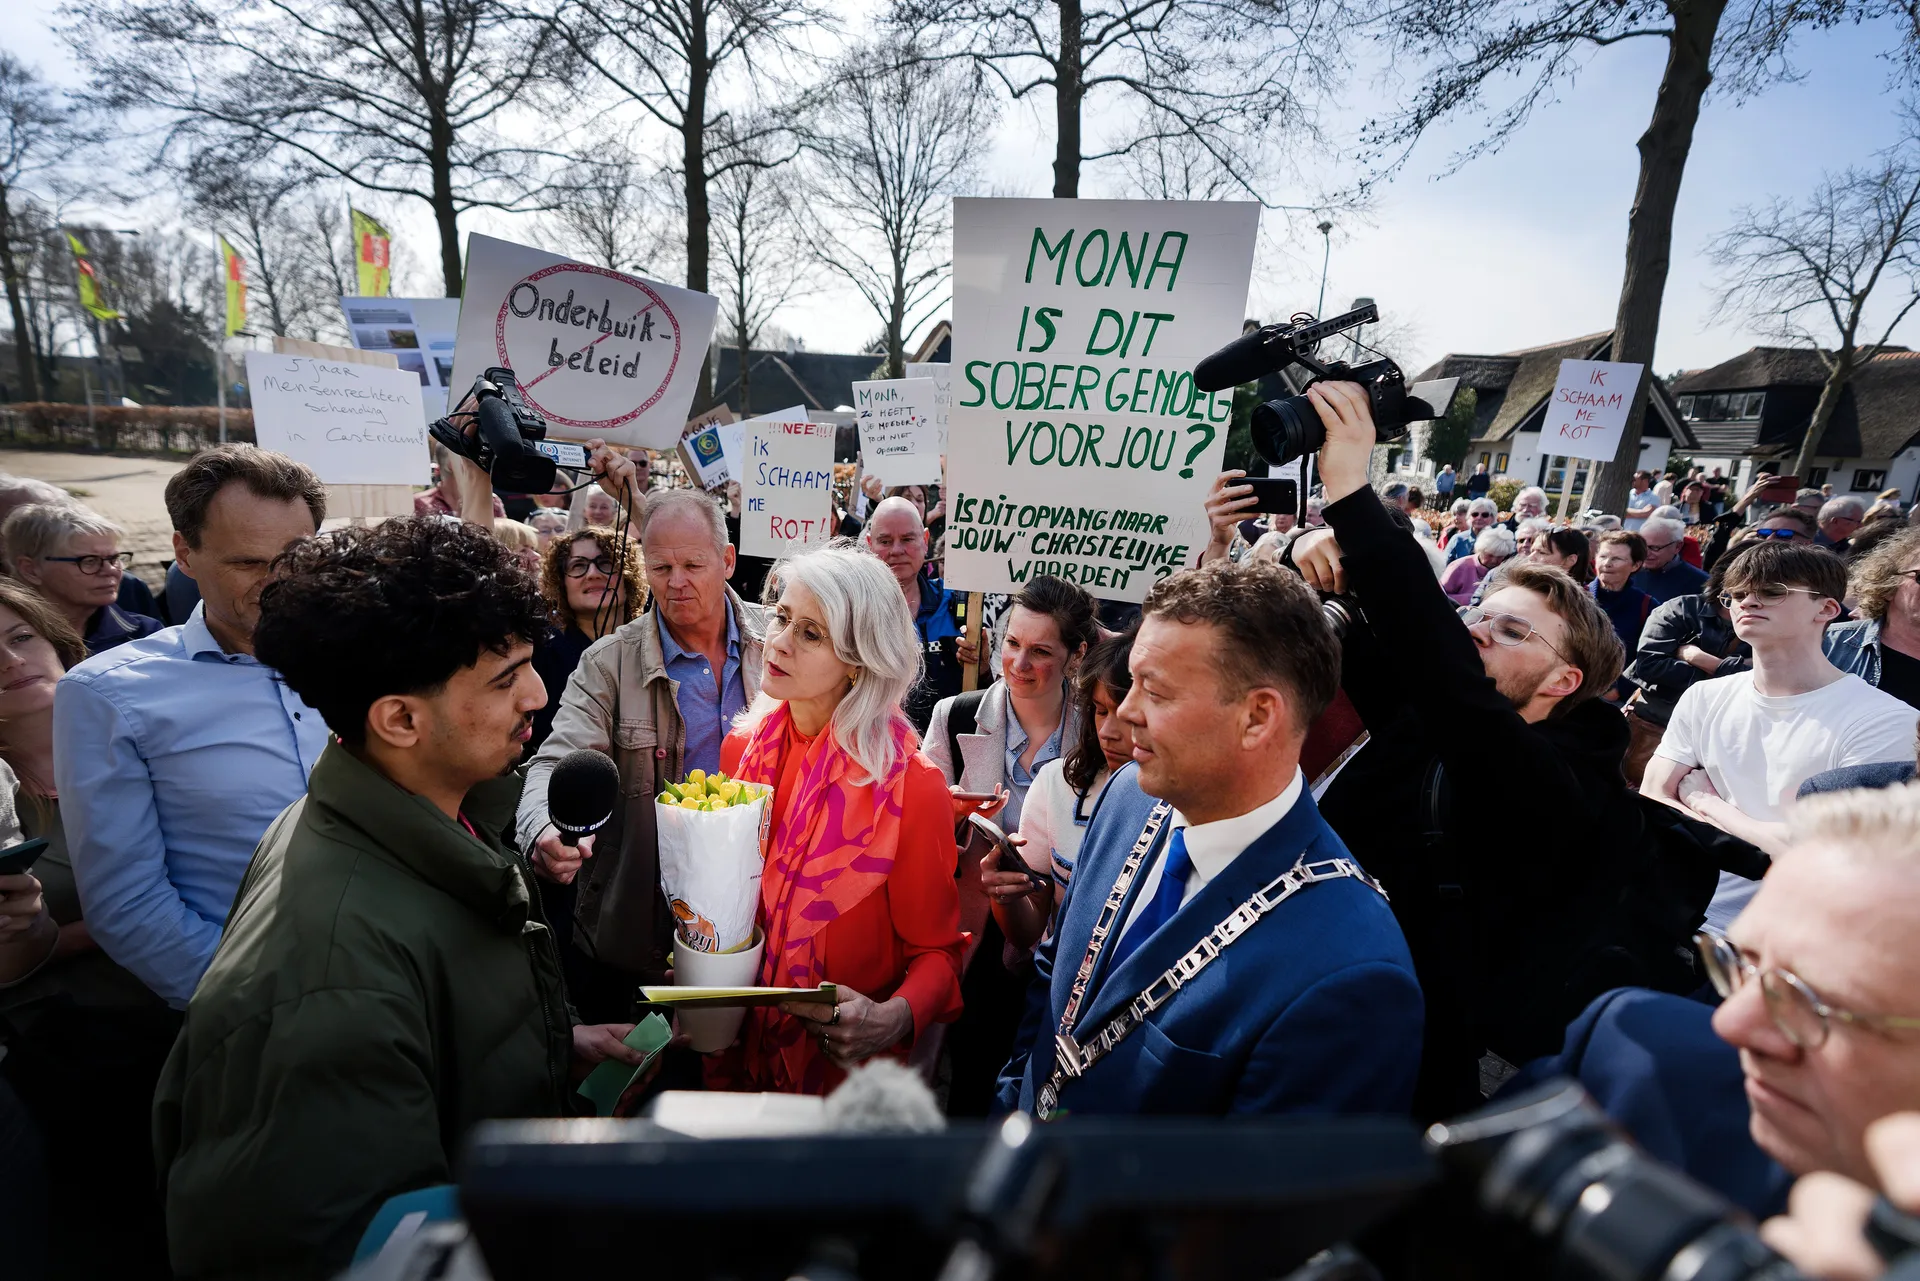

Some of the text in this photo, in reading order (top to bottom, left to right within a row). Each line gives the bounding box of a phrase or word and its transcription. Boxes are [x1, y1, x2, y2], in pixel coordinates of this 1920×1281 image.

[1024, 227, 1188, 292] MONA
[509, 282, 672, 342] Onderbuik-
[1016, 306, 1175, 359] IS DIT
[285, 358, 302, 373] 5
[263, 375, 411, 405] Mensenrechten
[960, 360, 1100, 411] SOBER
[1556, 387, 1623, 410] SCHAAM
[878, 419, 914, 430] MOEDER
[880, 406, 915, 417] HEEFT
[1575, 408, 1596, 421] ME
[286, 430, 306, 442] in
[868, 431, 913, 444] TOCH NIET
[1006, 420, 1104, 467] VOOR
[1559, 423, 1606, 440] ROT
[755, 462, 831, 491] SCHAAM
[748, 497, 766, 512] ME
[770, 515, 827, 543] ROT!
[1017, 504, 1109, 531] OPVANG
[1108, 509, 1169, 535] NAAR
[1031, 531, 1190, 572] CHRISTELIJKE
[1007, 558, 1130, 591] WAARDEN
